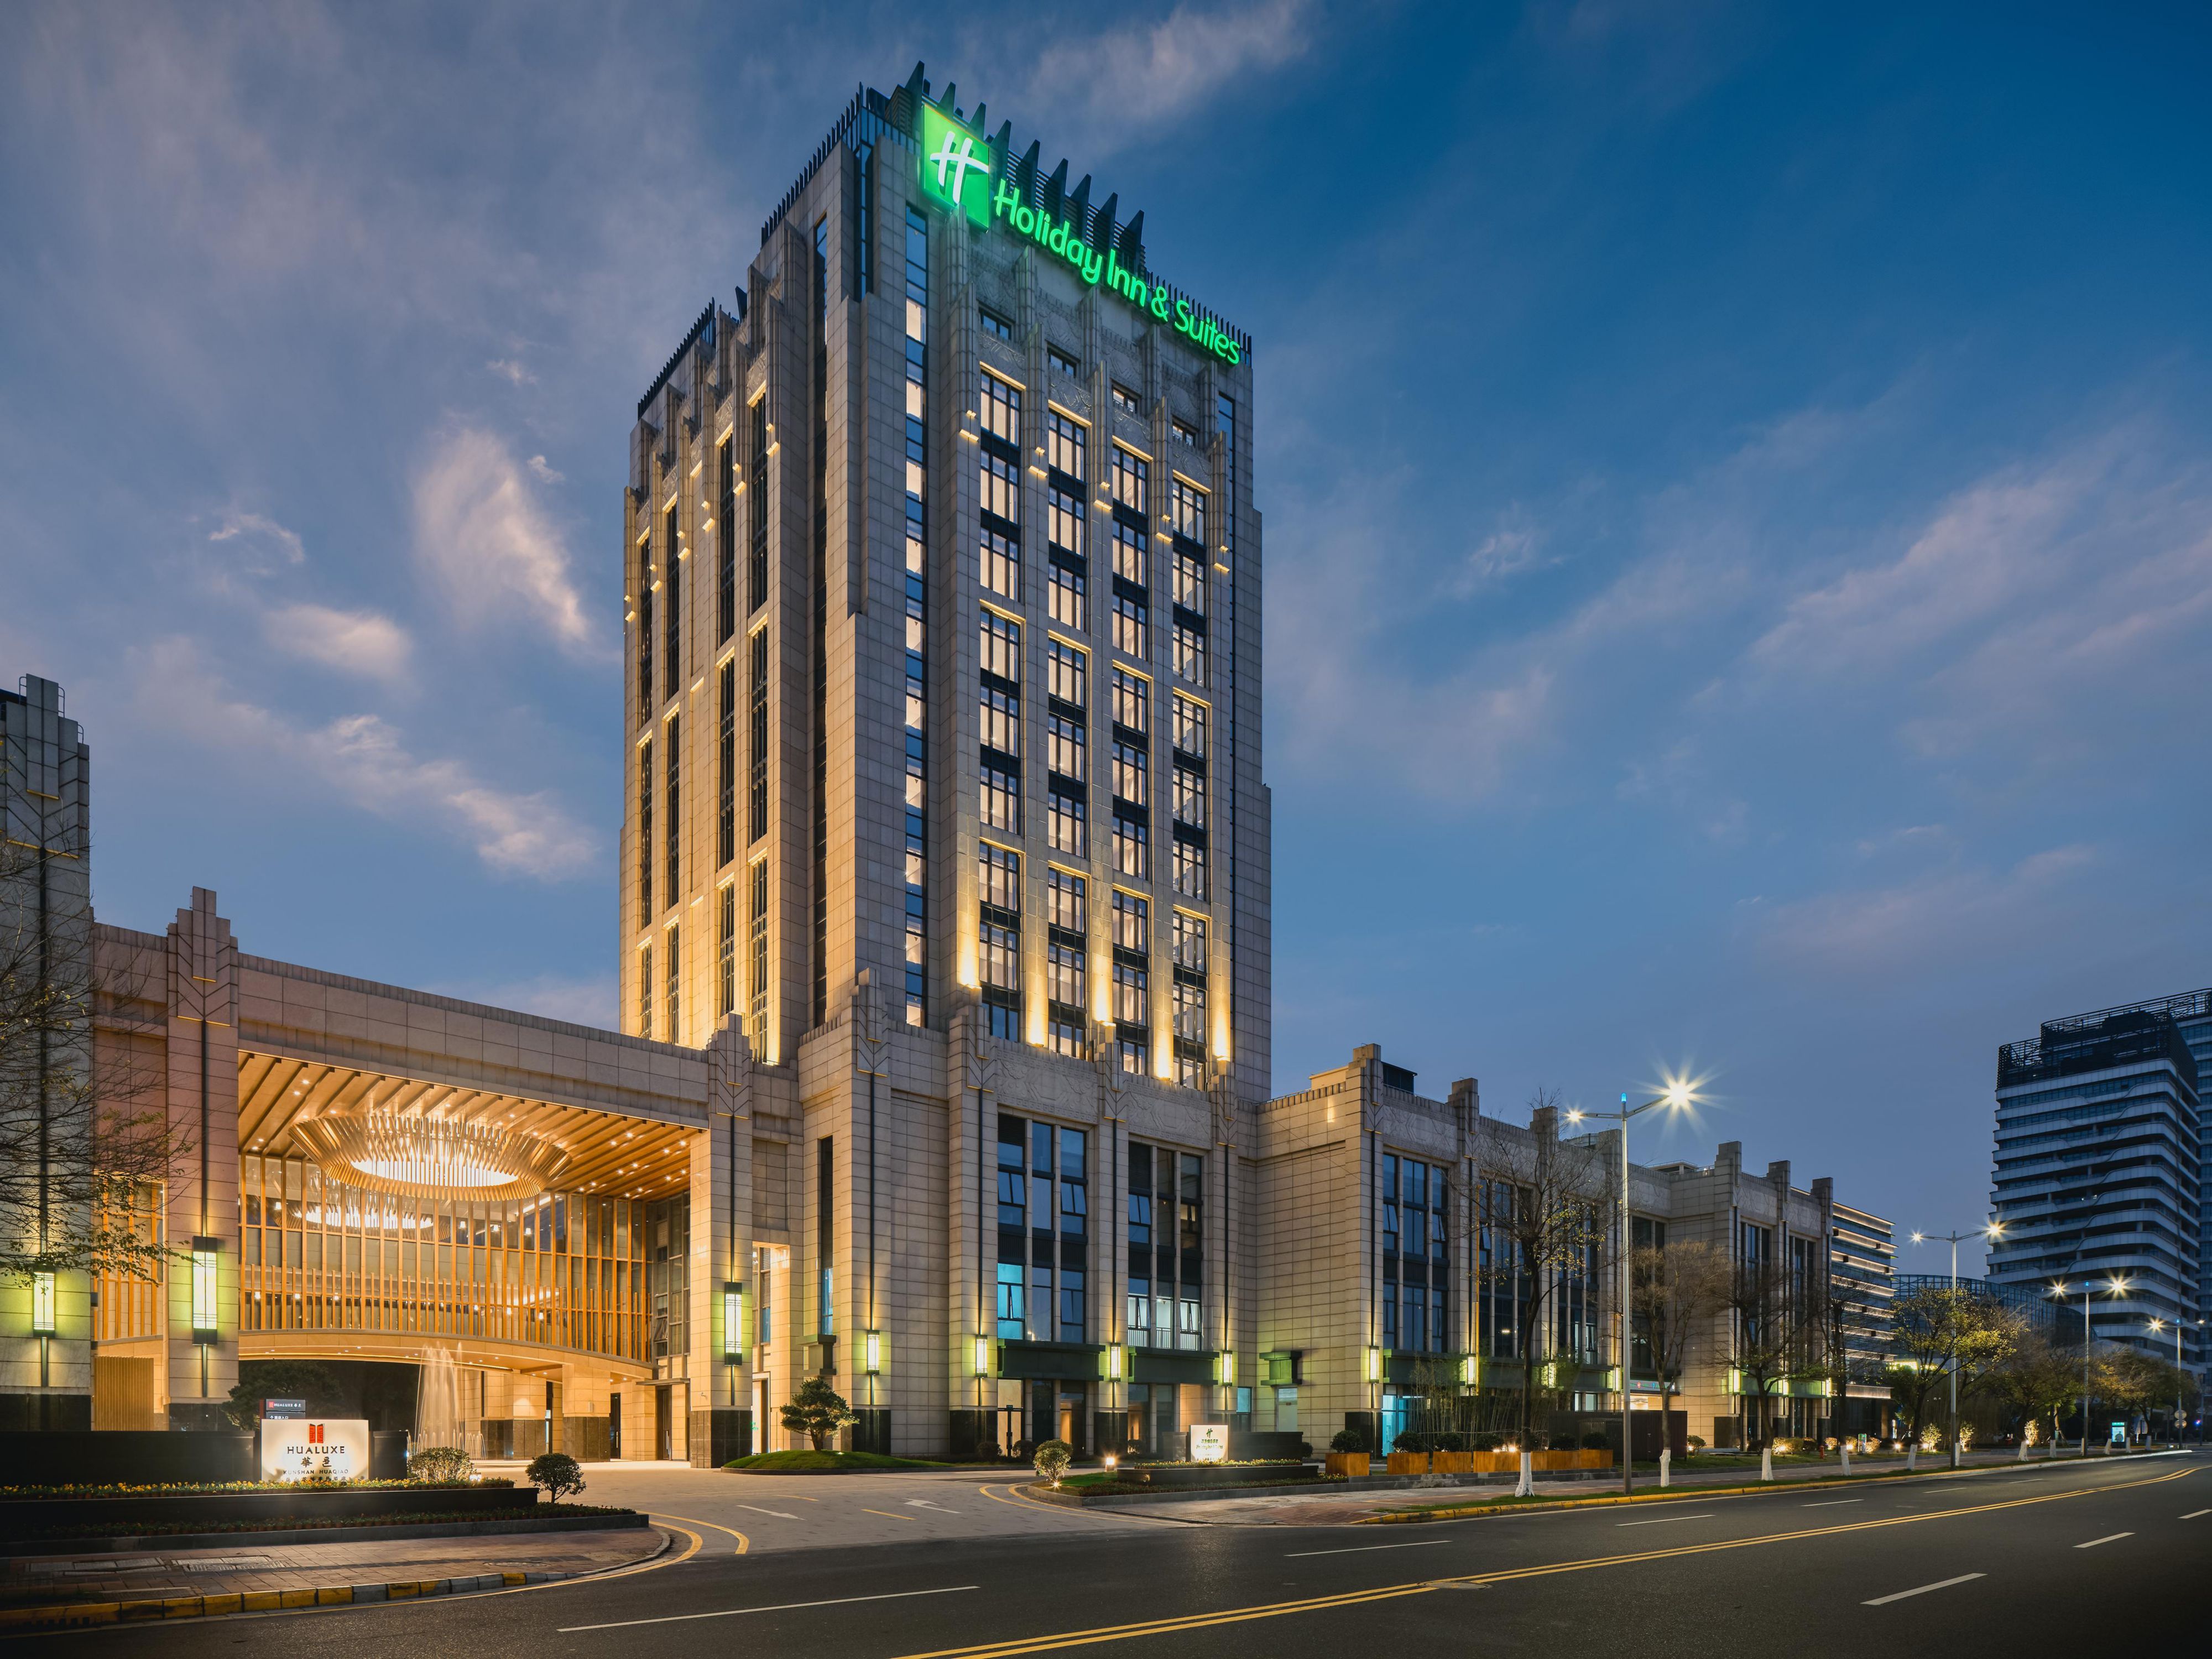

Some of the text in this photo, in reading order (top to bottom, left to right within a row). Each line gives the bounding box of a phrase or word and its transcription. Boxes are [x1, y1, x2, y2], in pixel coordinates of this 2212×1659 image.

[993, 178, 1240, 364] Holiday Inn & Suites
[287, 1446, 345, 1454] HUALUXE
